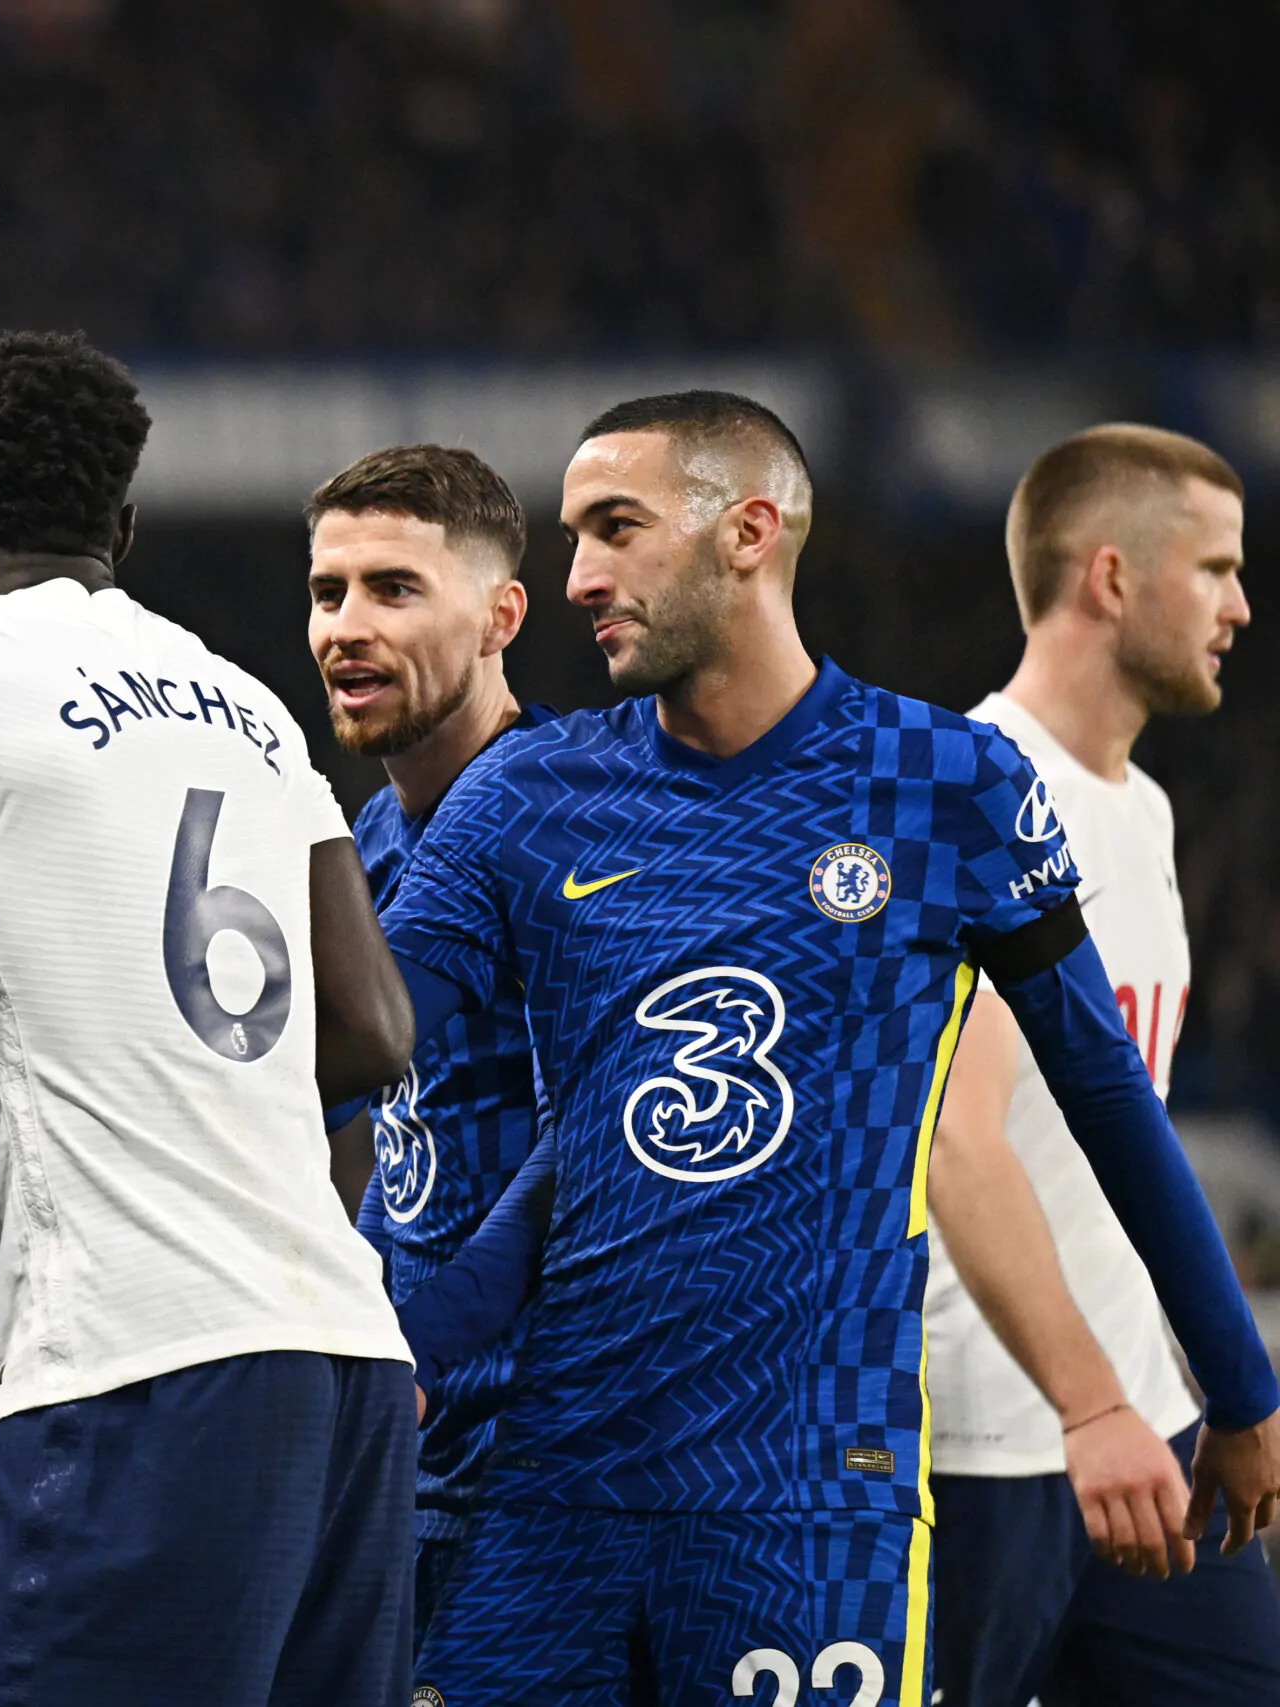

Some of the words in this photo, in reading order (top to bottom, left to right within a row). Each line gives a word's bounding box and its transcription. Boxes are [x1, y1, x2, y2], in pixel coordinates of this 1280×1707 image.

[60, 667, 281, 776] SÁNCHEZ
[826, 846, 879, 866] CHELSEA
[162, 787, 292, 1063] 6
[821, 901, 855, 918] FOOTBALL
[857, 905, 875, 917] CLUB
